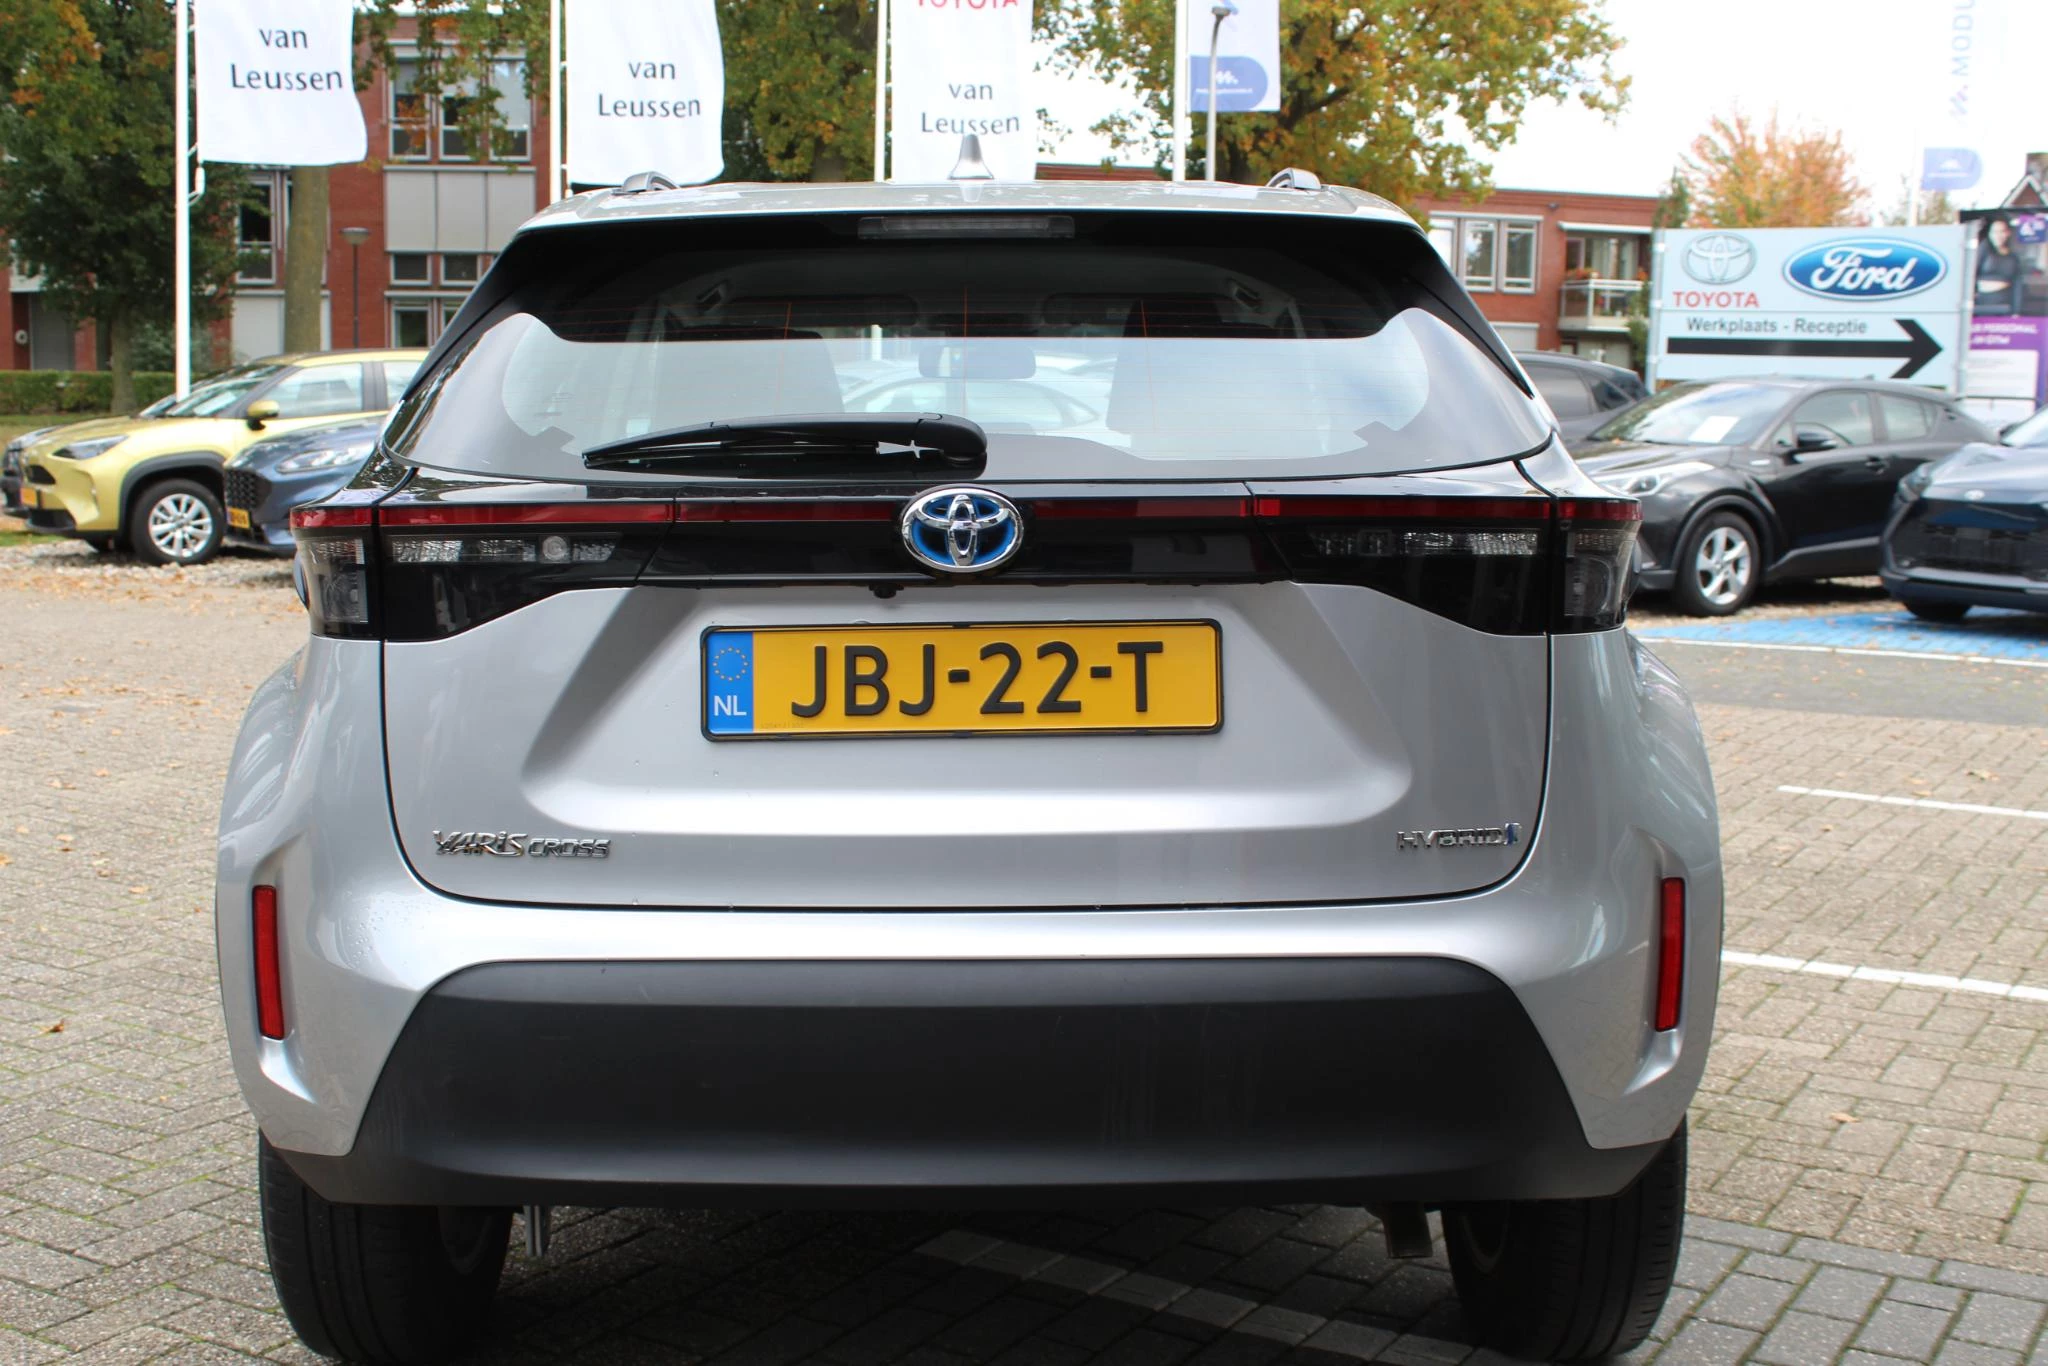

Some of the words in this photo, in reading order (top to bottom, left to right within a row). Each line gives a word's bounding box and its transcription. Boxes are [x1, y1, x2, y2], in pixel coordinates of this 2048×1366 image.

[259, 27, 308, 49] van
[230, 63, 343, 91] Leussen
[628, 59, 676, 80] van
[948, 81, 993, 101] van
[598, 93, 701, 118] Leussen
[921, 111, 1020, 135] Leussen
[1810, 246, 1918, 290] Ford
[1672, 291, 1760, 308] TOYOTA
[1687, 317, 1777, 334] Werkplaats
[1794, 318, 1867, 335] Receptie
[791, 640, 1163, 718] JBJ-22-T
[713, 695, 747, 716] NL
[528, 837, 611, 858] CROSS
